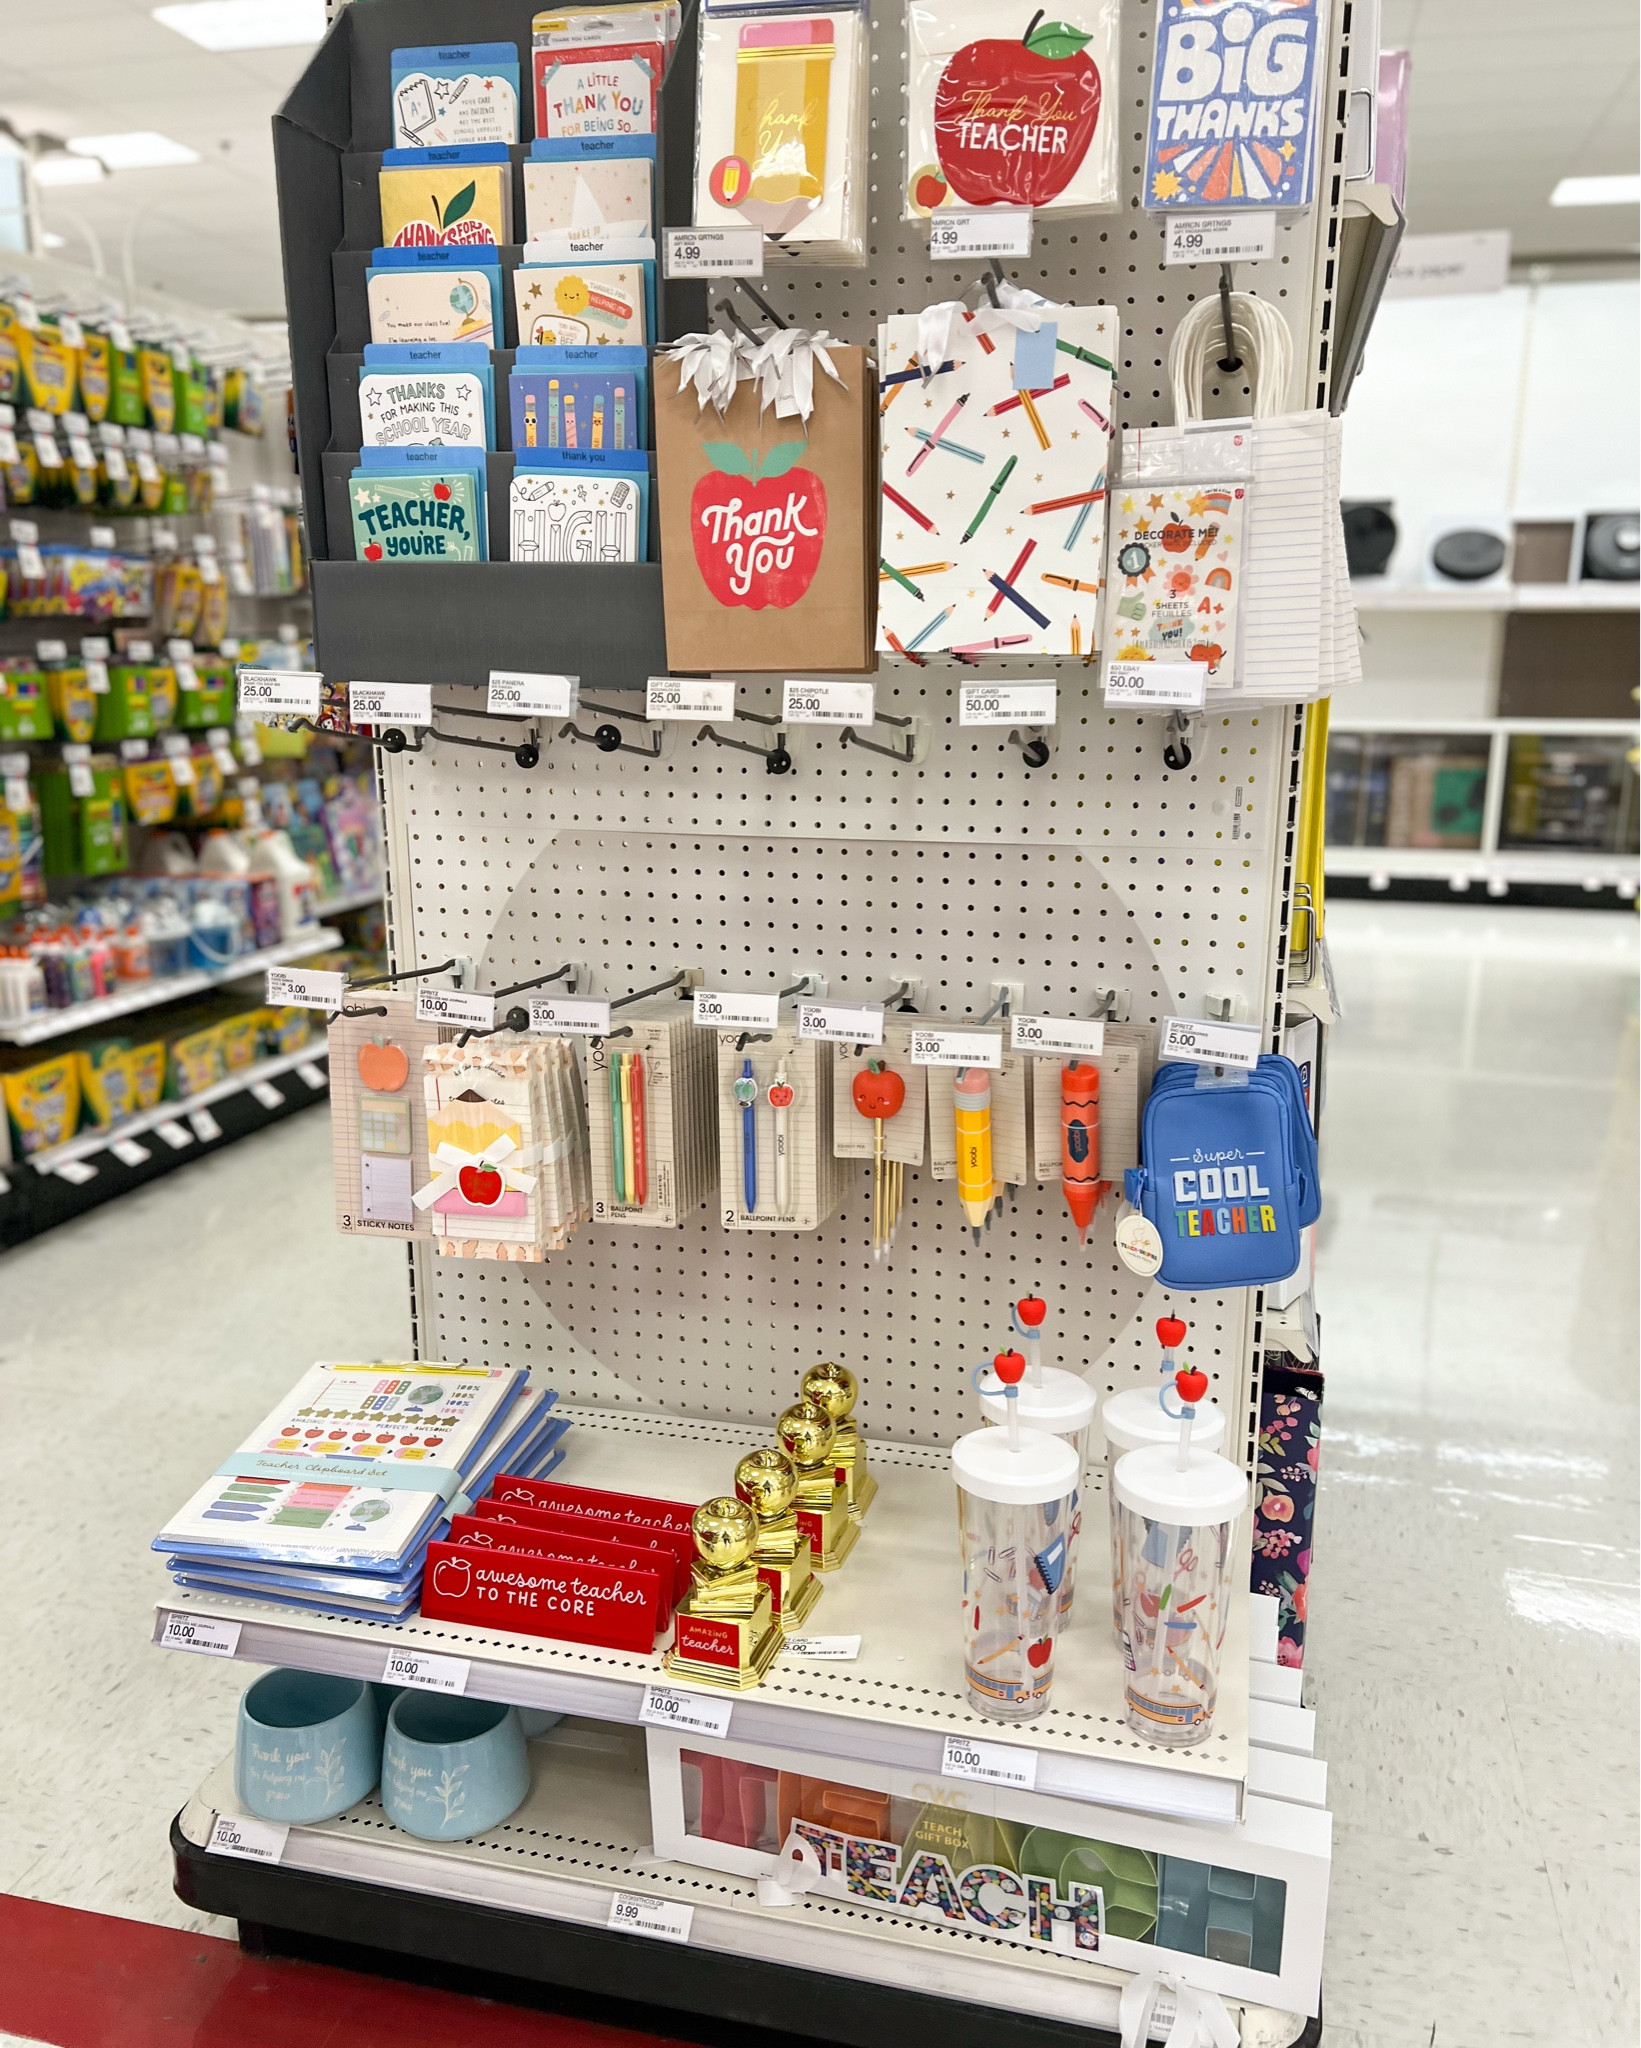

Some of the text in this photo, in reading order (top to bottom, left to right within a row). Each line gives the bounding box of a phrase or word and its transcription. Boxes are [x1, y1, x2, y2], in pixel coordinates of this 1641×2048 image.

[438, 50, 471, 60] teacher
[577, 78, 585, 89] A
[553, 90, 643, 118] THANK YOU
[954, 85, 1077, 130] Thank You
[1157, 98, 1305, 141] THANKS
[561, 122, 580, 136] FOR
[957, 122, 1069, 154] TEACHER
[581, 141, 615, 151] teacher
[428, 151, 461, 161] teacher
[459, 220, 483, 237] FOR
[1174, 219, 1232, 229] AMRCN GRTNGS
[931, 231, 958, 244] 4.99
[1174, 234, 1203, 248] 4.99
[570, 242, 604, 252] teacher
[674, 246, 701, 259] 4.99
[418, 252, 450, 261] teacher
[410, 350, 442, 361] teacher
[565, 349, 598, 359] teacher
[386, 381, 446, 405] THANKS
[380, 402, 460, 424] FOR MAKING THIS
[376, 416, 472, 447] SCHOOL YEAR
[406, 452, 438, 461] teacher
[562, 450, 606, 464] thank you
[358, 499, 471, 541] TEACHER,
[701, 492, 818, 544] Thank
[1134, 528, 1219, 541] DECORATE ME!
[386, 530, 447, 557] YOU'RE
[725, 531, 795, 596] You
[1169, 589, 1177, 599] 3
[1197, 596, 1224, 614] A+
[1161, 628, 1183, 640] YOU!
[1109, 676, 1144, 688] 50.00
[244, 686, 272, 697] 25.00
[491, 689, 521, 701] 25.00
[650, 692, 681, 704] 25.00
[353, 700, 381, 711] 25.00
[789, 698, 820, 710] 25.00
[966, 699, 1000, 711] 50.00
[287, 984, 306, 994] 3.00
[420, 989, 439, 997] SPRITZ
[420, 999, 448, 1012] 10.00
[699, 1003, 723, 1014] 3.00
[533, 1009, 555, 1020] 3.00
[803, 1016, 827, 1028] 3.00
[1171, 1022, 1194, 1030] SPRITZ
[1017, 1027, 1043, 1039] 3.00
[1169, 1032, 1196, 1046] 5.00
[915, 1042, 940, 1053] 3.00
[1193, 1148, 1244, 1166] Super
[1173, 1165, 1270, 1204] COOL
[596, 1202, 604, 1214] 3
[610, 1205, 644, 1213] BALLPOINT
[343, 1215, 351, 1227] 3
[725, 1210, 734, 1222] 2
[740, 1214, 776, 1222] BALLPOINT
[1175, 1205, 1277, 1237] TEACHER
[357, 1219, 415, 1231] STICKY NOTES
[441, 1407, 465, 1415] 100%
[291, 1417, 325, 1425] AMAZING!
[256, 1460, 299, 1470] Teacher
[305, 1464, 366, 1476] Clipboard
[367, 1469, 388, 1477] Set
[476, 1568, 647, 1606] awesome teacher
[477, 1586, 595, 1617] TO THE CORE
[171, 1613, 189, 1621] SPRITZ
[169, 1624, 195, 1638] 10.00
[681, 1635, 735, 1656] teacher
[393, 1649, 412, 1657] SPRITZ
[391, 1660, 418, 1674] 10.00
[651, 1686, 671, 1695] SPRITZ
[650, 1697, 679, 1713] 10.00
[948, 1737, 970, 1746] SPRITZ
[286, 1752, 311, 1772] you
[948, 1750, 980, 1766] 10.00
[410, 1766, 433, 1783] you
[922, 1820, 962, 1837] TEACH
[217, 1831, 241, 1844] 10.00
[915, 1831, 969, 1849] GIFT BOX
[792, 1818, 1103, 1953] TEACH
[619, 1894, 665, 1907] COOKWITHCOLOR
[616, 1904, 638, 1918] 9.99
